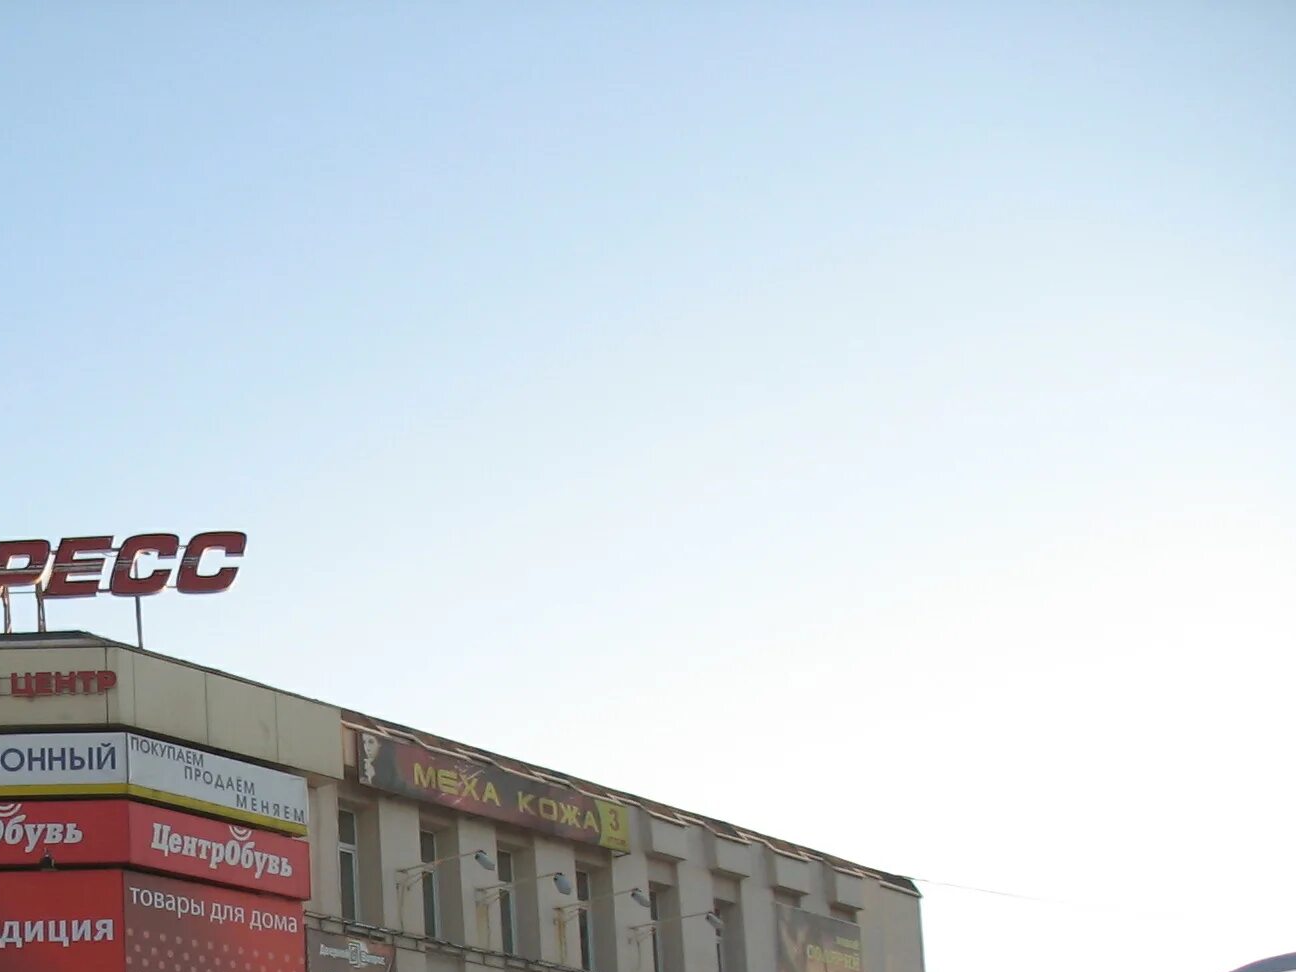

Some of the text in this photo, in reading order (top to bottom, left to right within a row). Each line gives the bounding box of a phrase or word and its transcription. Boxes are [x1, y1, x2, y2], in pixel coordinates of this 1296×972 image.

[11, 670, 116, 698] ЦЕНТР
[130, 735, 204, 768] ПОКУПАЕМ
[236, 794, 305, 824] МЕНЯЕМ
[413, 762, 600, 833] МЕХА КОЖА
[151, 822, 293, 879] ЦентрОбувь
[129, 886, 298, 933] товары для дома
